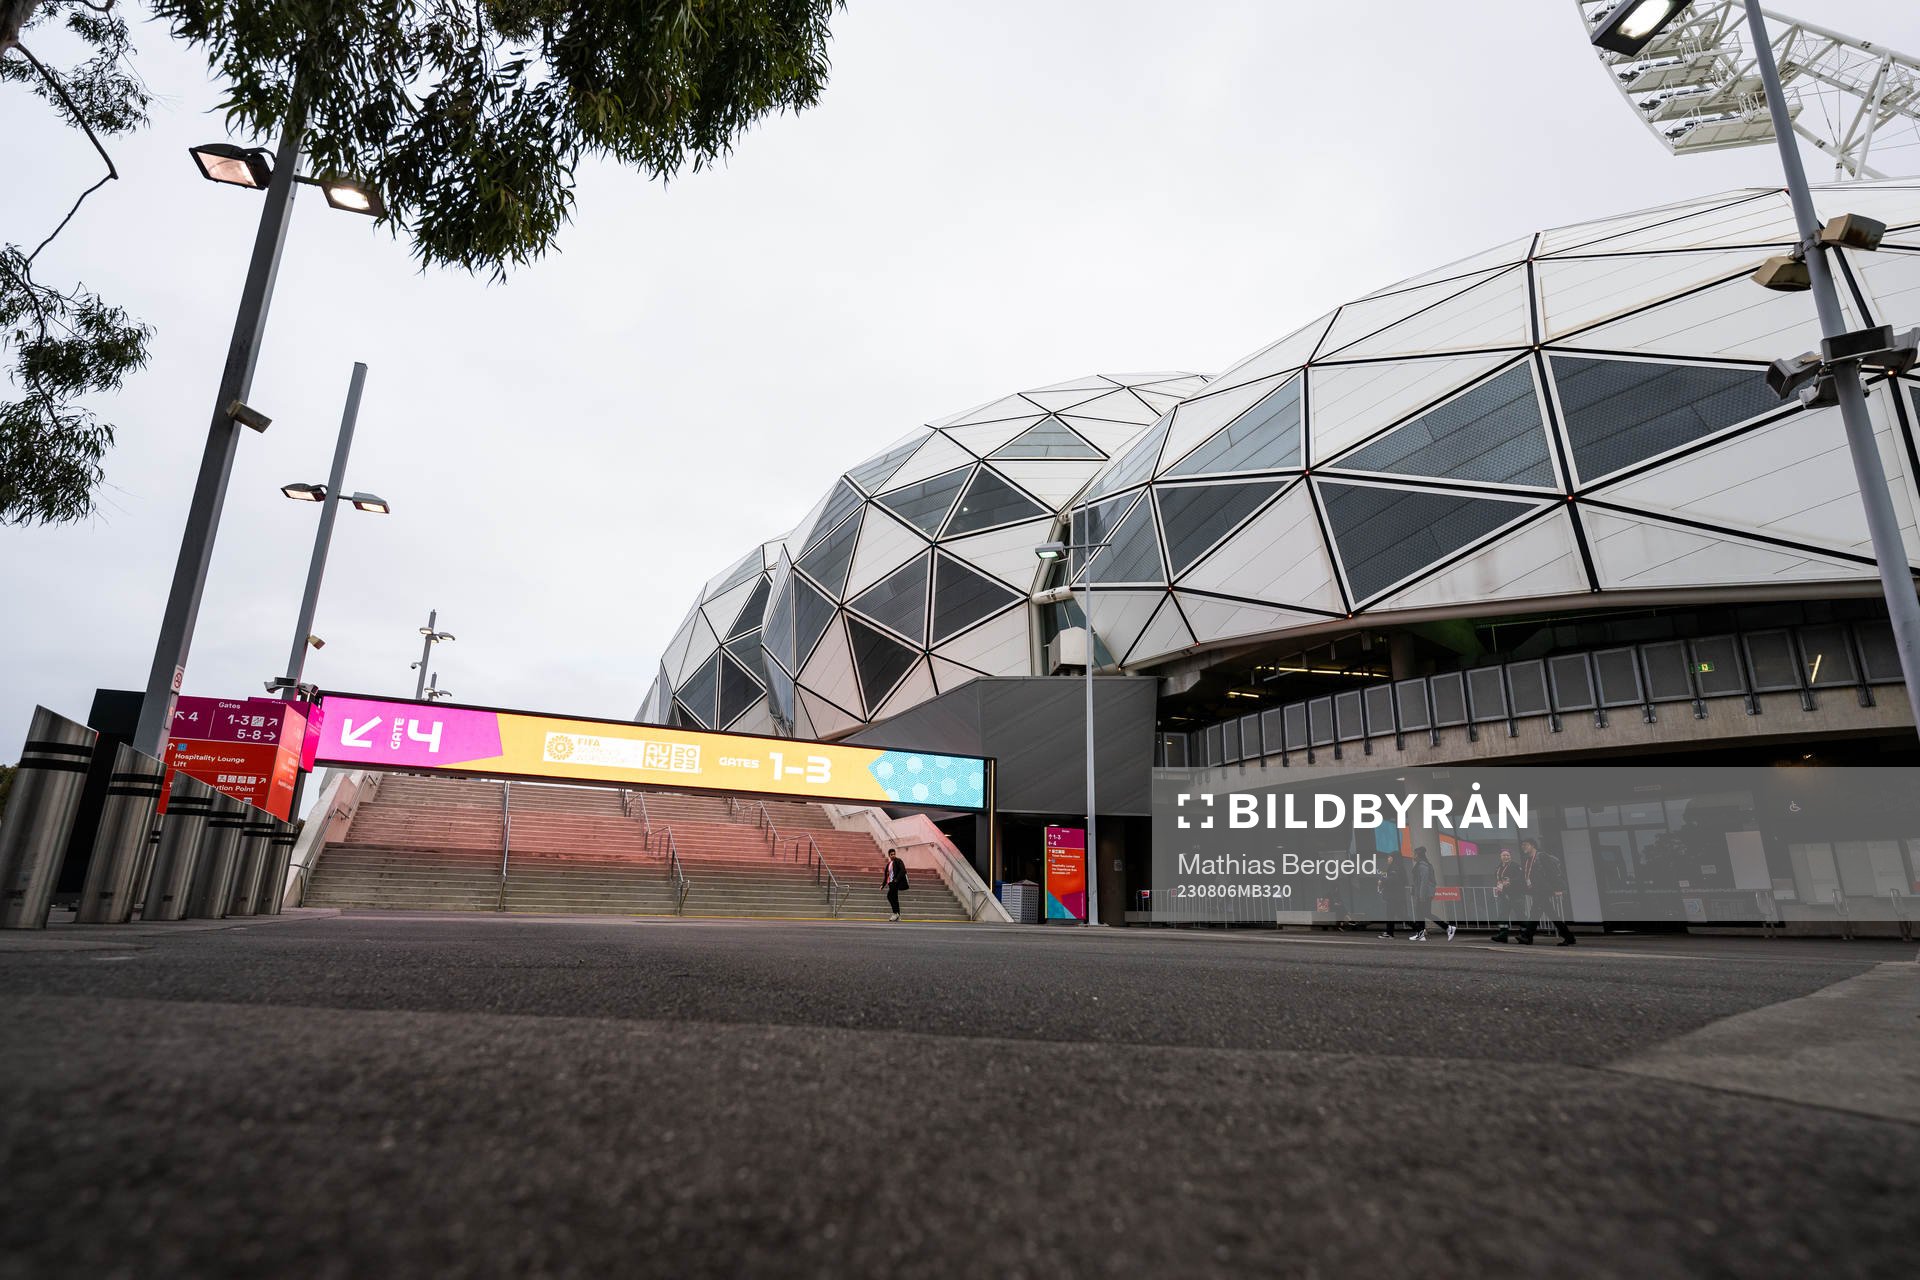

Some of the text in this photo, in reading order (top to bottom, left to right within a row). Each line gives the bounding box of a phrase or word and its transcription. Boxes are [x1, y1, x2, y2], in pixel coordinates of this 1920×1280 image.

[188, 711, 199, 722] 4
[227, 714, 250, 725] 1-3
[237, 728, 262, 740] 5-8
[390, 717, 444, 753] GATE 4
[578, 736, 600, 747] FIFA
[175, 753, 245, 764] Hospitality Lounge
[719, 756, 761, 769] GATES
